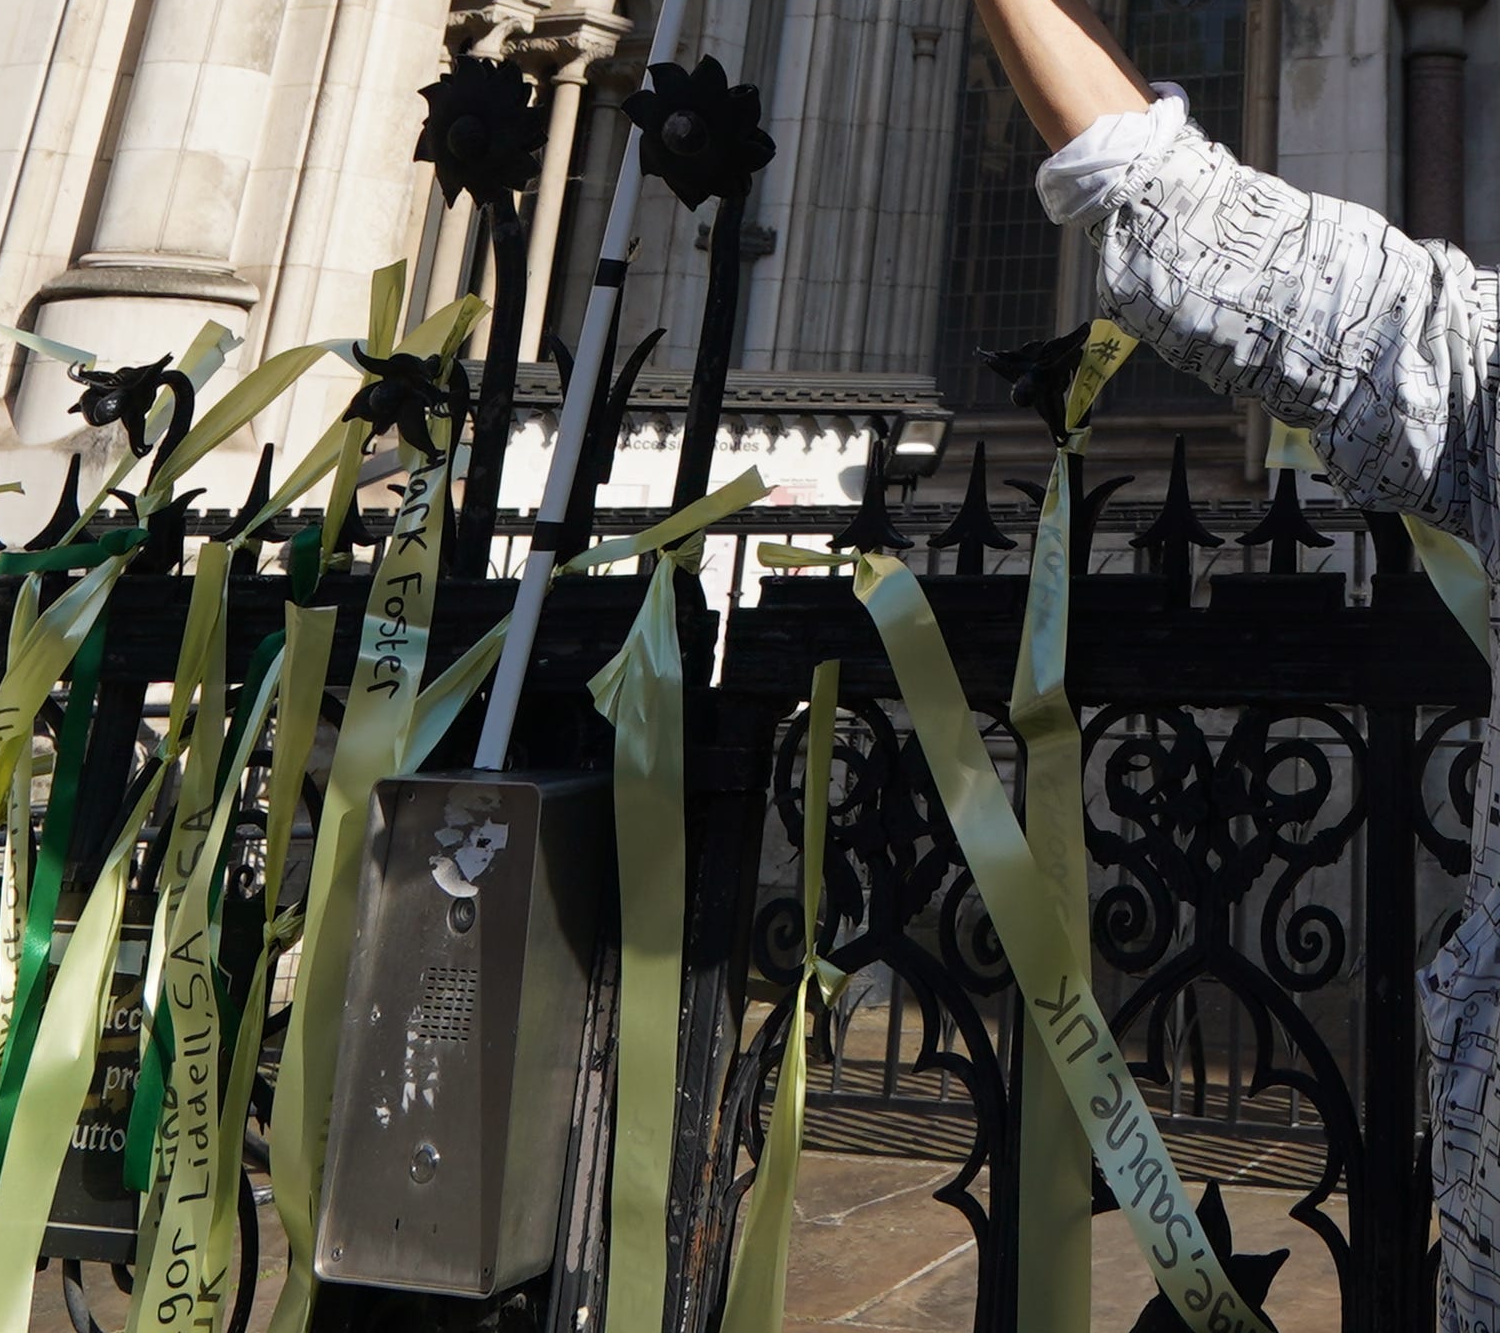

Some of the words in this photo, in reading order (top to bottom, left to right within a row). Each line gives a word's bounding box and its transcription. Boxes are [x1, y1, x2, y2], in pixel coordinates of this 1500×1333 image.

[366, 572, 422, 699] Foster
[169, 929, 212, 1012] SA
[1033, 975, 1101, 1065] UK
[71, 1122, 127, 1153] utto
